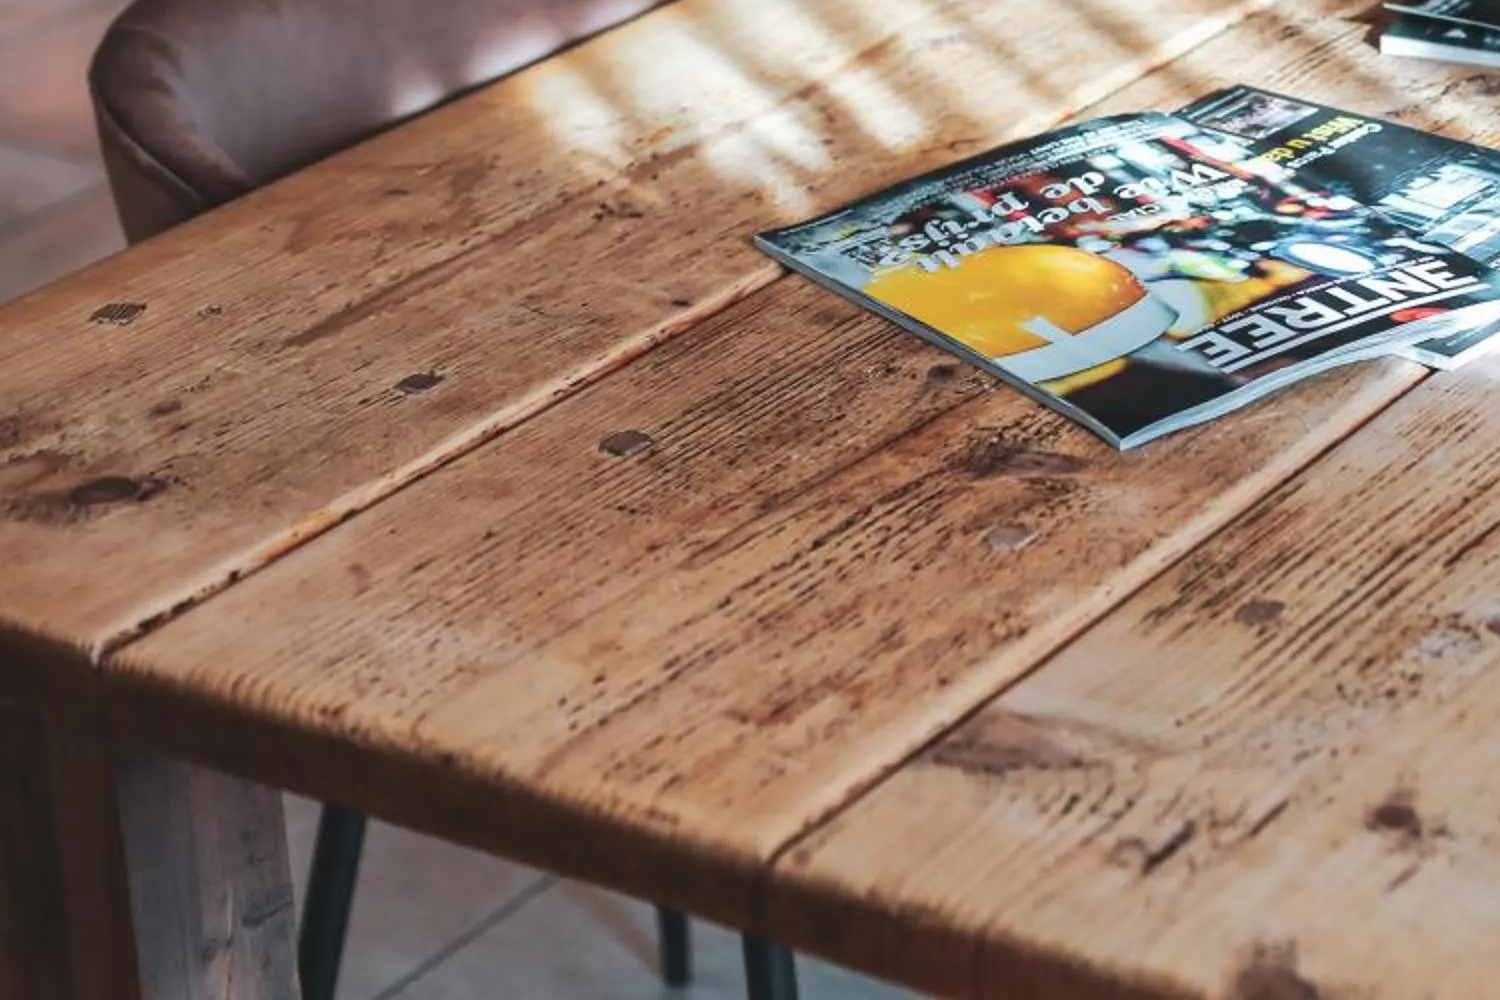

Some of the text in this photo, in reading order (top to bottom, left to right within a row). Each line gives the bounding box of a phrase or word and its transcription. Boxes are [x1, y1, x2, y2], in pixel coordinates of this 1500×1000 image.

[1038, 171, 1105, 199] de
[1112, 162, 1227, 200] Wie
[1175, 257, 1479, 366] ENTREE
